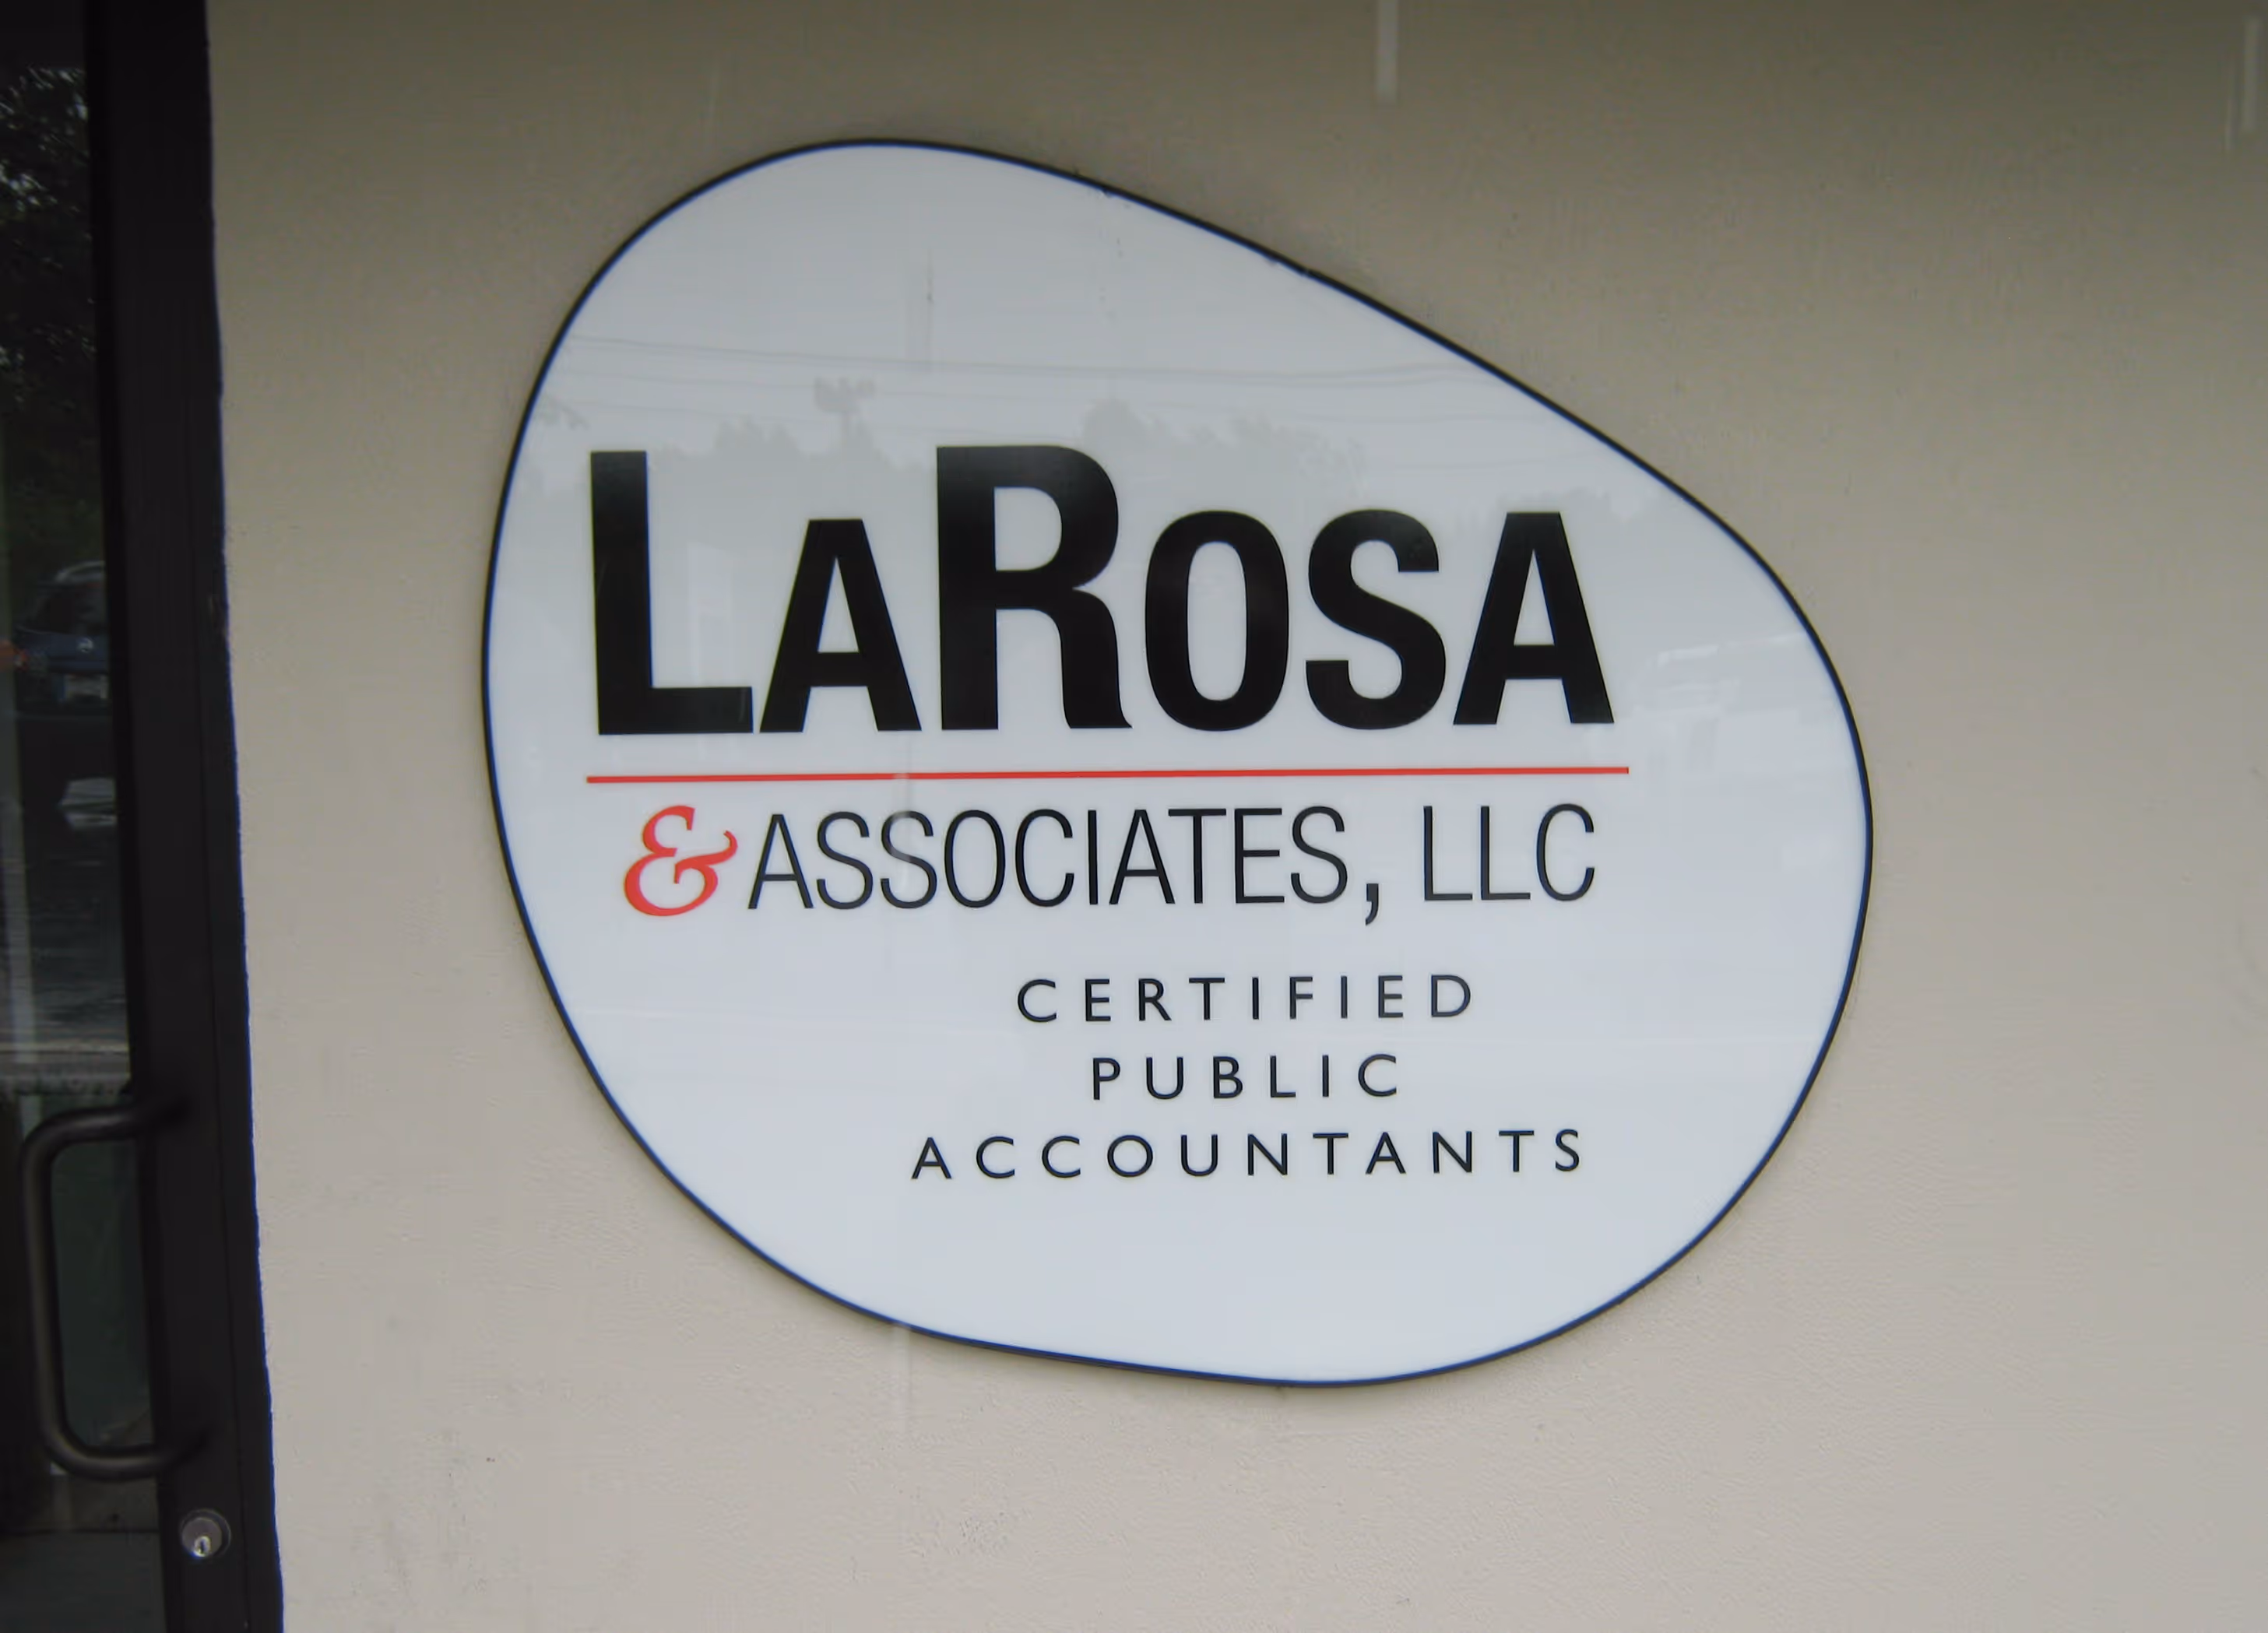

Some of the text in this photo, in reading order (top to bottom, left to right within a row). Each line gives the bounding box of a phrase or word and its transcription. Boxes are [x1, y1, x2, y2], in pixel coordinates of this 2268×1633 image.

[623, 805, 1595, 926] & ASSOCIATES, LLC
[1017, 974, 1472, 1024] CERTIFIED
[1092, 1053, 1398, 1101] PUBLIC
[911, 1129, 1580, 1180] ACCOUNTANTS
